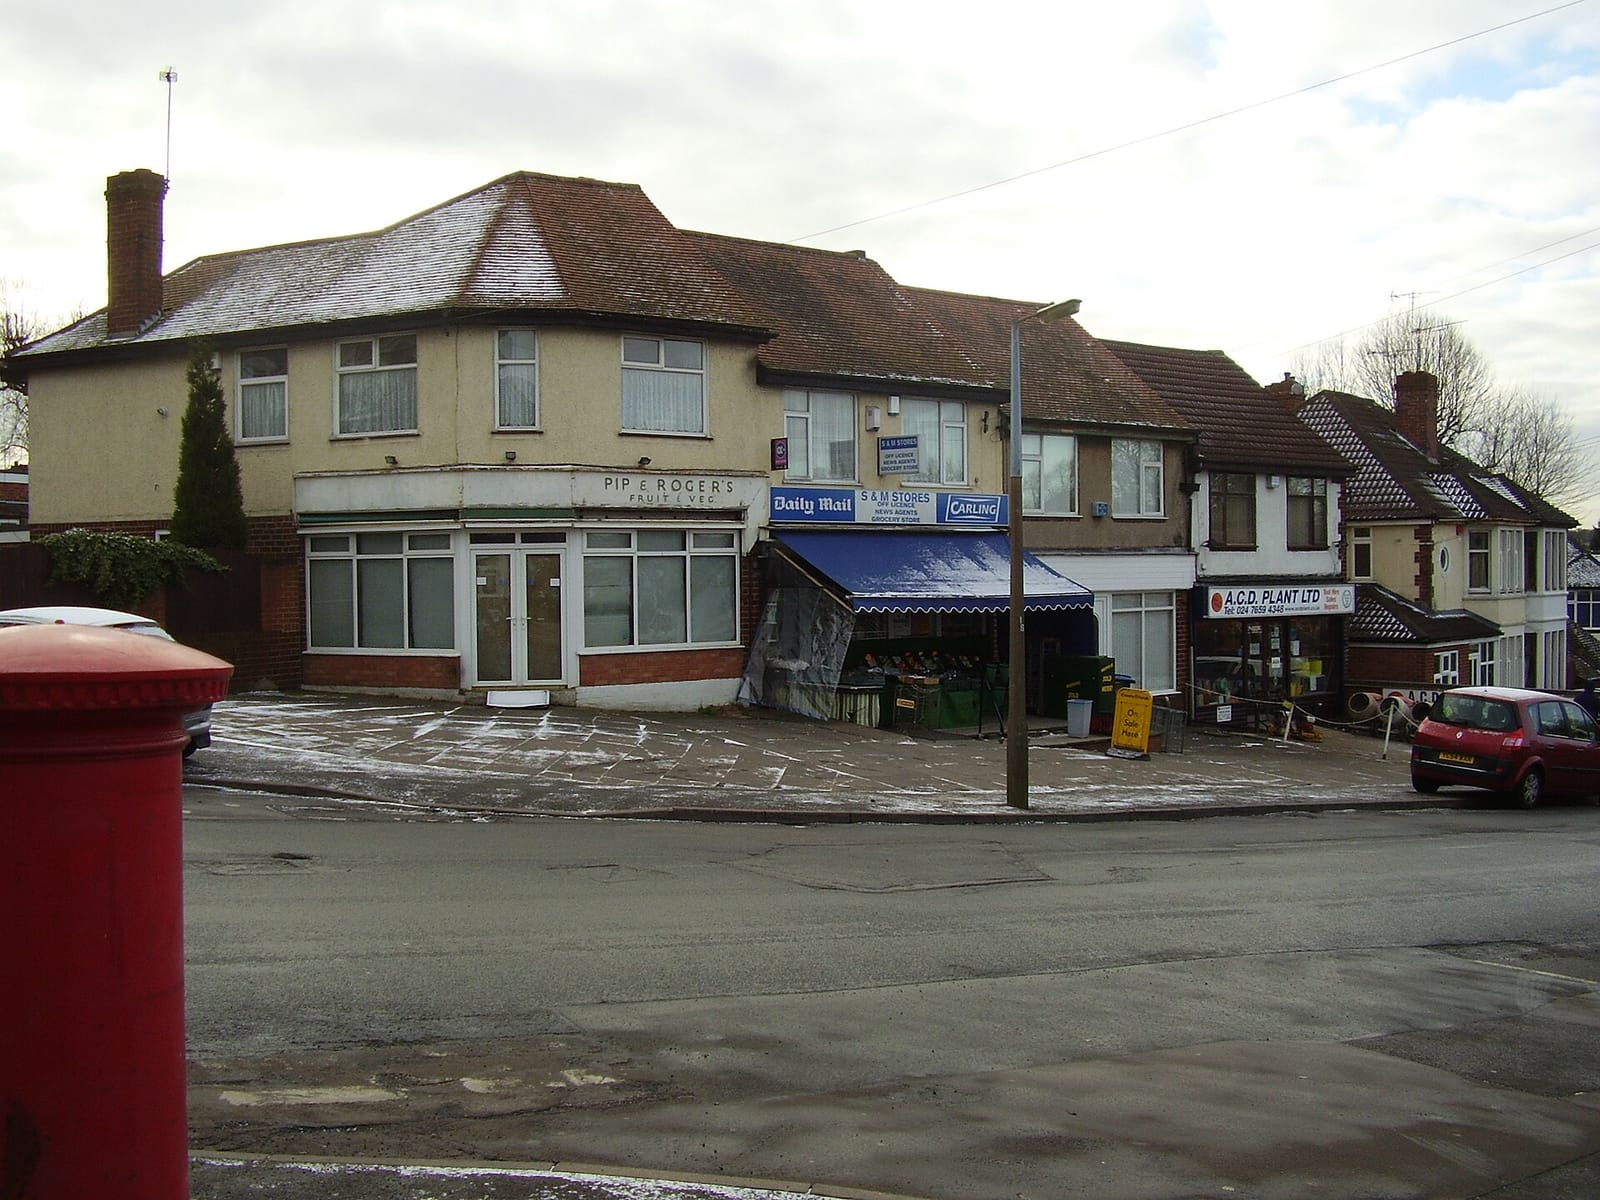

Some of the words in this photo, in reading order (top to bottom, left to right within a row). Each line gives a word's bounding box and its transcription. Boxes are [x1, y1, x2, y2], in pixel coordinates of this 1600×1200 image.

[896, 438, 917, 446] STORES
[604, 477, 630, 491] PIP
[657, 479, 733, 493] ROGER'S
[630, 494, 669, 503] FRUIT
[861, 491, 868, 501] S
[871, 491, 877, 501] &
[880, 491, 889, 501] M
[892, 492, 930, 503] STORES
[774, 496, 815, 515] Daily
[818, 497, 852, 511] Mail
[950, 501, 997, 515] CARLING
[1224, 590, 1258, 605] A.C.D.
[1262, 589, 1299, 604] PLANT
[1301, 589, 1320, 603] LTD
[1236, 606, 1249, 615] 024
[1124, 719, 1138, 728] Sale
[1121, 729, 1139, 738] Here
